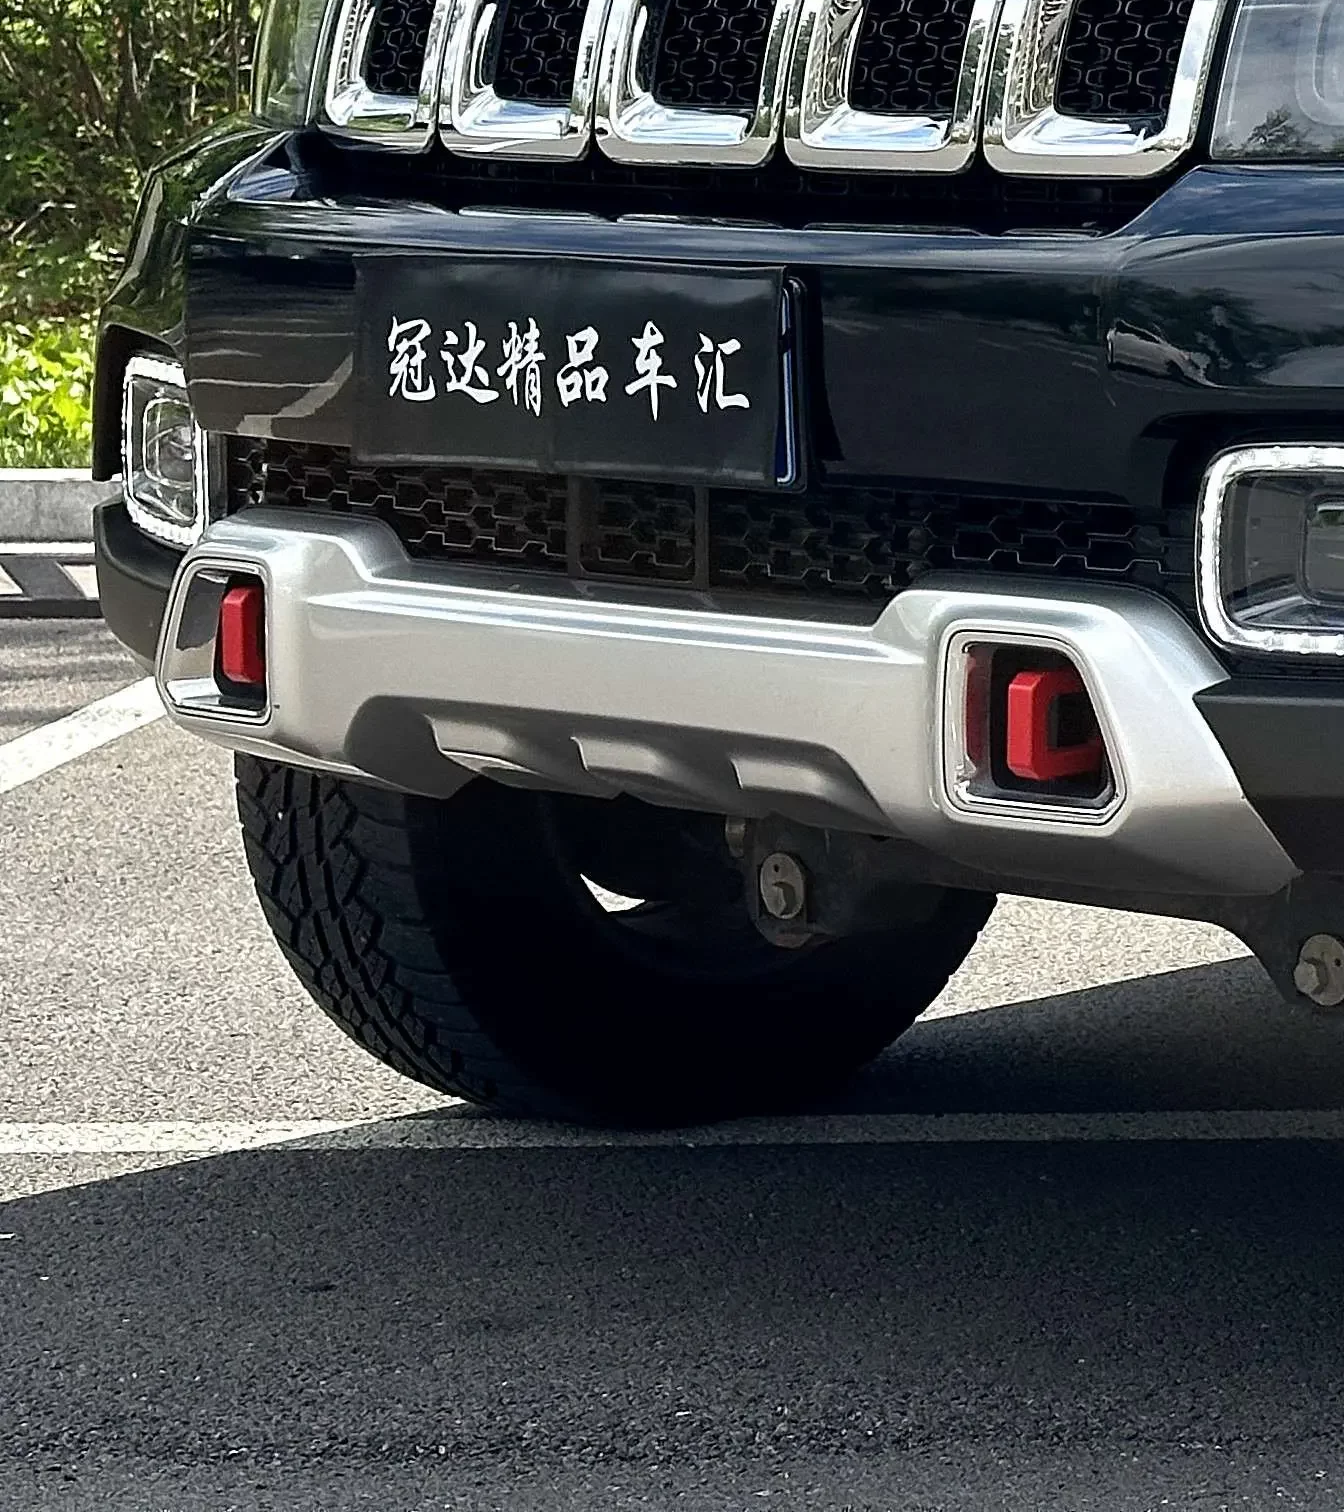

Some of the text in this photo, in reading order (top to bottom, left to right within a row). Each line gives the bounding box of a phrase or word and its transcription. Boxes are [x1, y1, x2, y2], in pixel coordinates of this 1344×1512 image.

[386, 314, 751, 422] 冠达精品车汇
